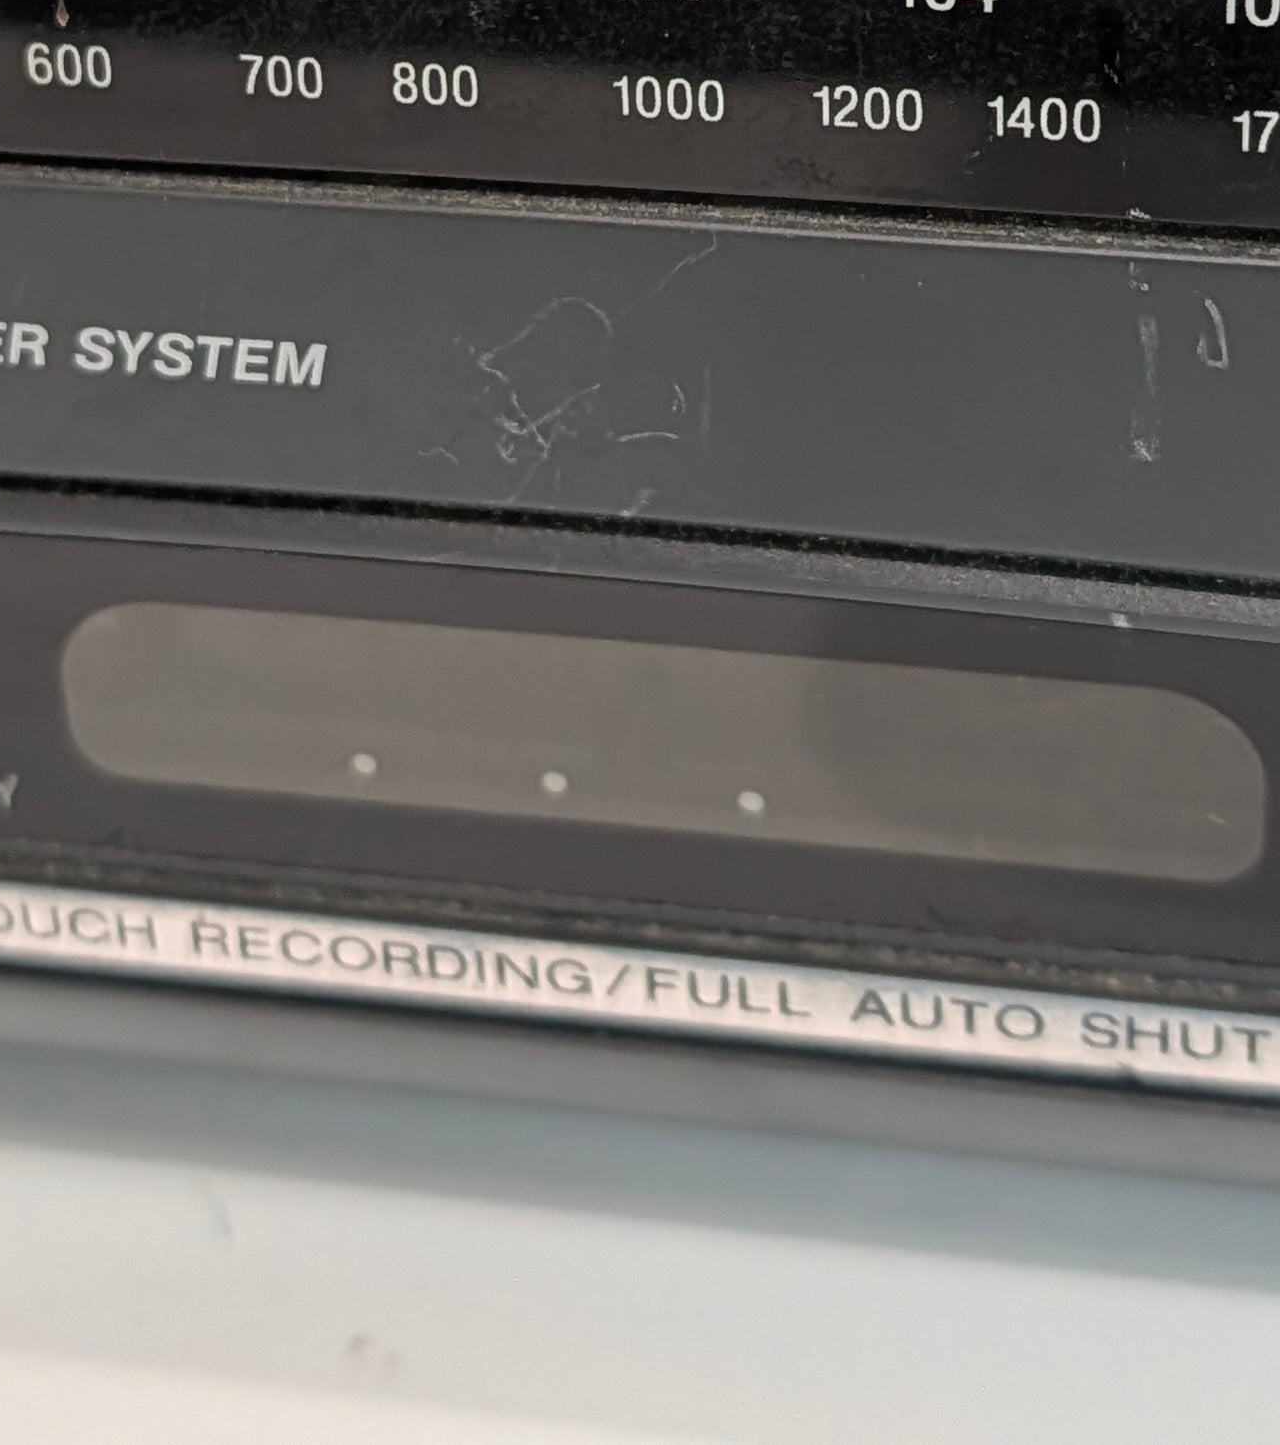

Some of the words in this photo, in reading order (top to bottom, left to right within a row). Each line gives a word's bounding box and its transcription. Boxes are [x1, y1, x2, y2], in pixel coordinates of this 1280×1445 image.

[24, 40, 114, 91] 600
[237, 51, 325, 101] 700
[390, 59, 481, 110] 800
[610, 73, 727, 124] 1000
[810, 82, 925, 134] 1200
[985, 93, 1103, 145] 1400
[73, 328, 328, 386] SYSTEM
[191, 917, 810, 1021] RECORDING/FULL
[850, 987, 1045, 1042] AUTO
[1079, 1012, 1272, 1066] SHUT
